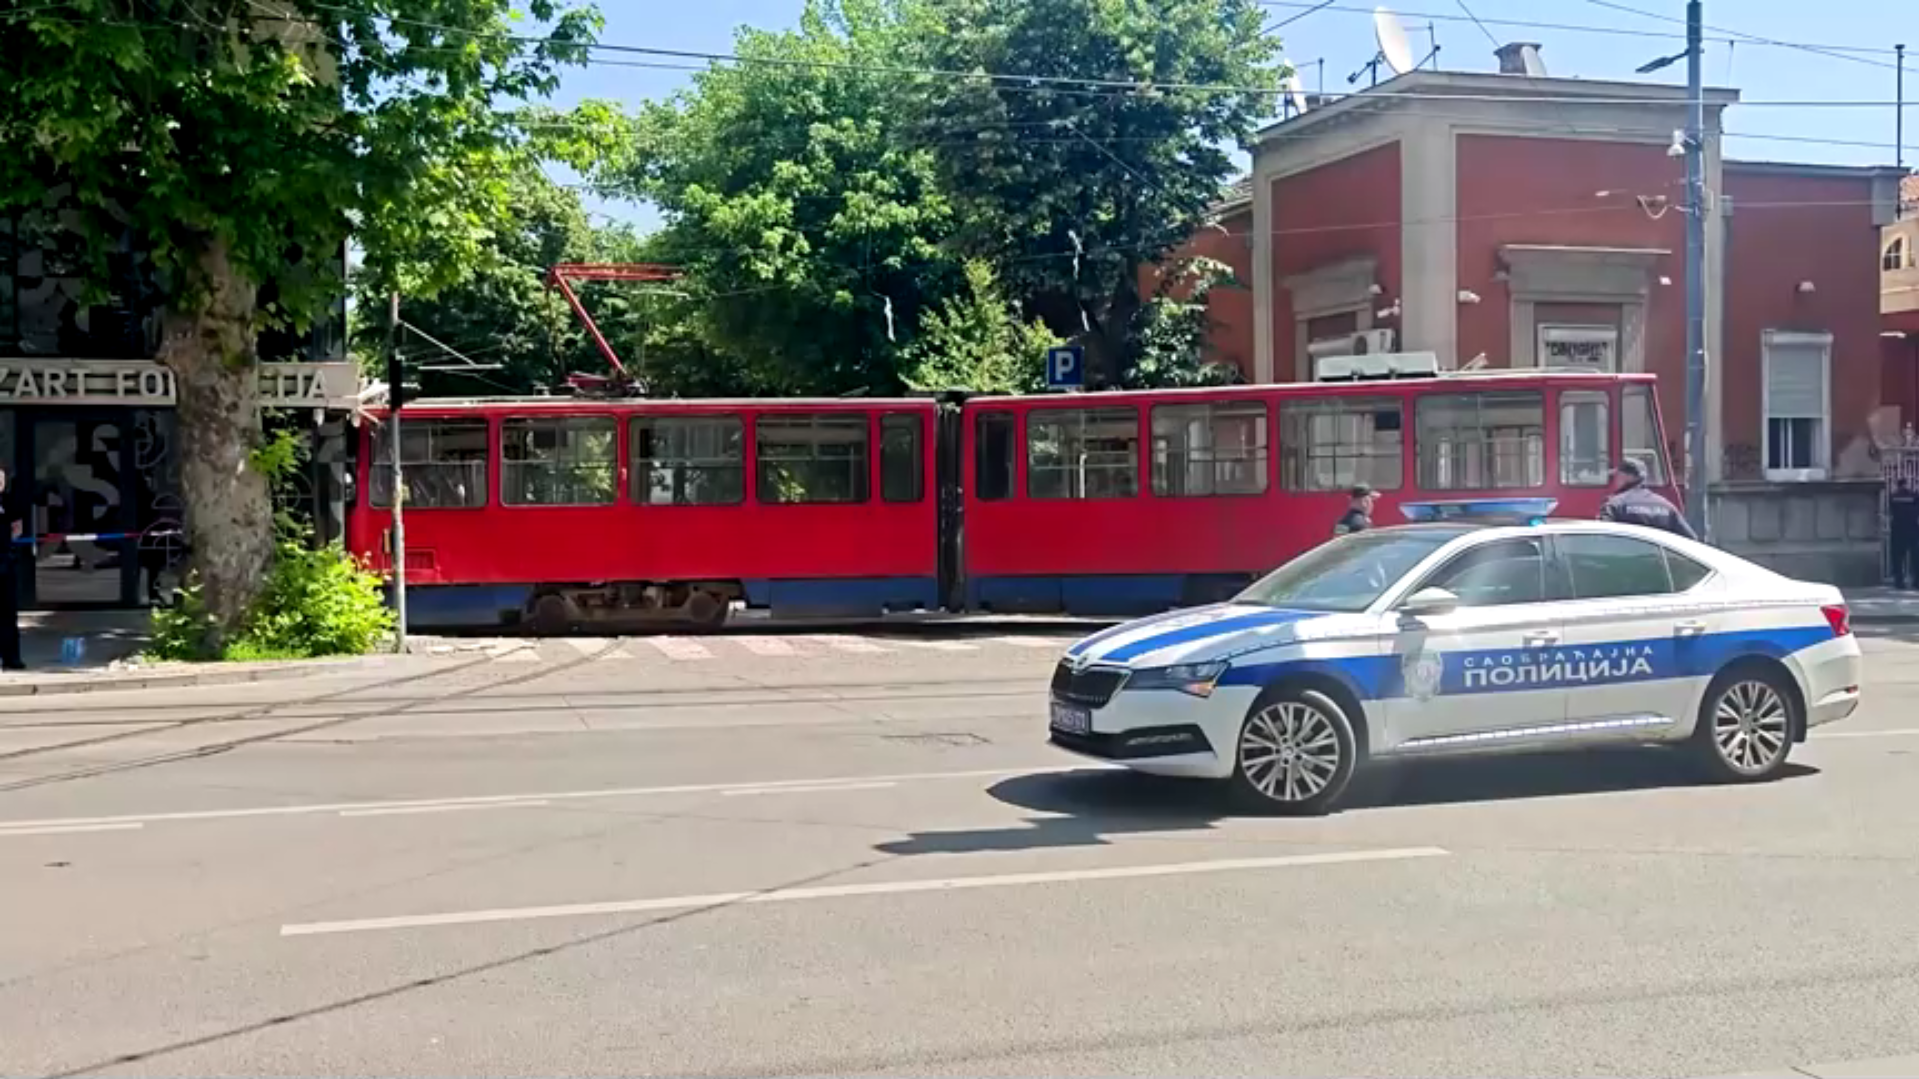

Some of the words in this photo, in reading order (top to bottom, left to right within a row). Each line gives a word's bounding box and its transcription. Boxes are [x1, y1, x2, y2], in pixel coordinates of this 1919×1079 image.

[1055, 351, 1075, 381] P
[1464, 646, 1654, 667] САОБРАЋАЈНА
[1464, 657, 1653, 687] ПОЛИЦИЈА
